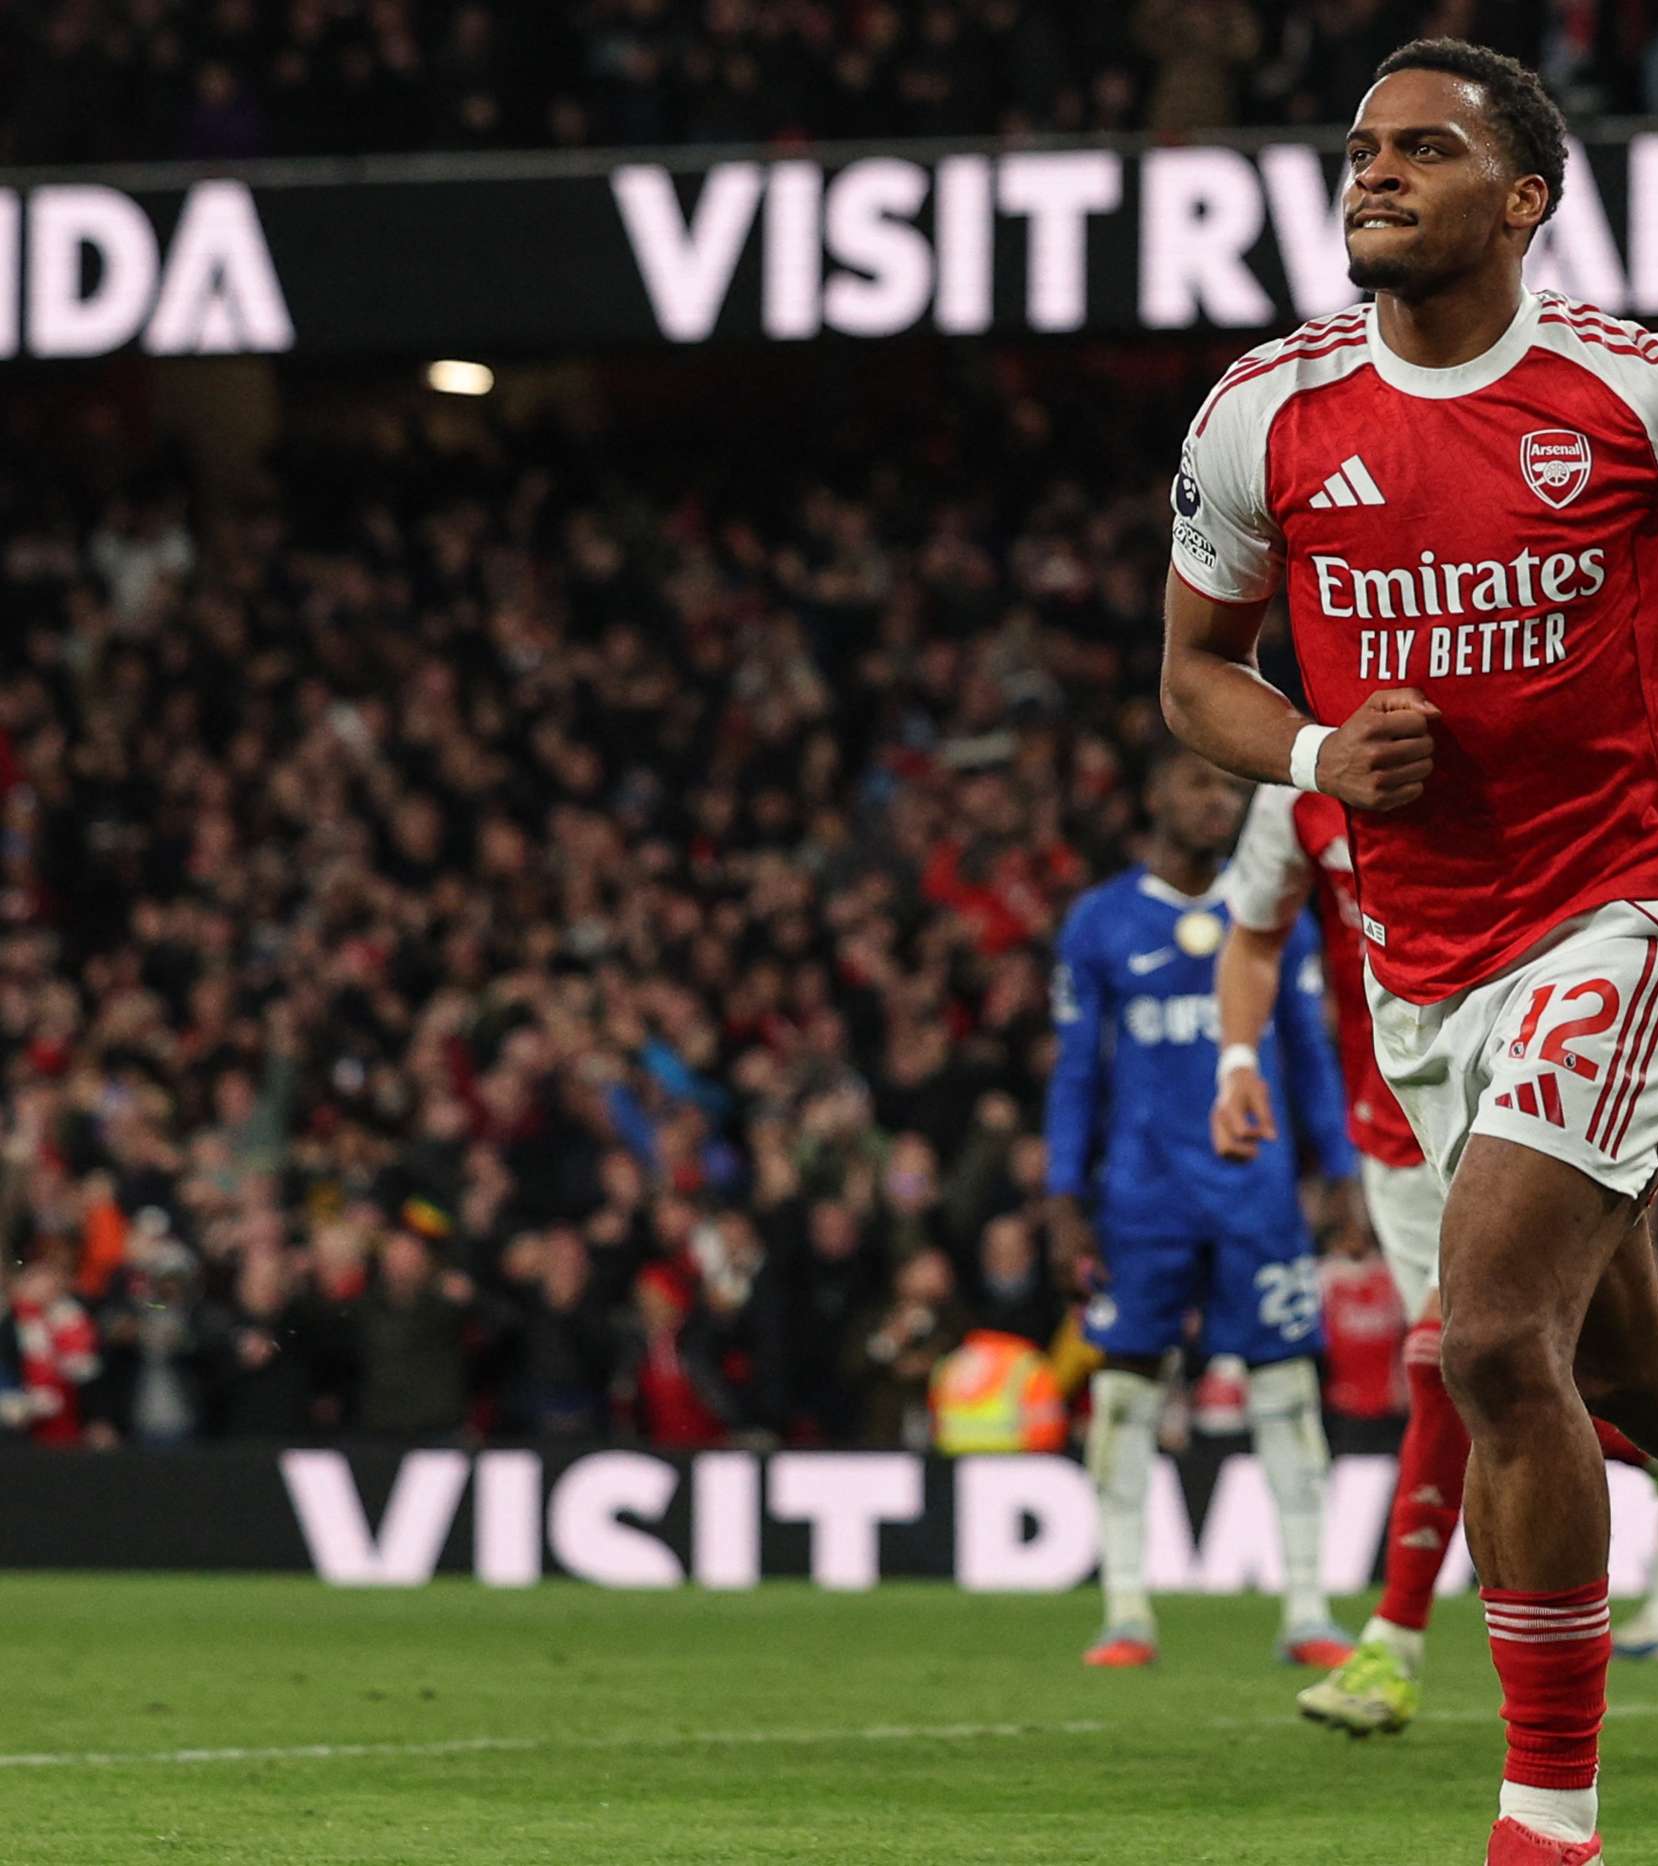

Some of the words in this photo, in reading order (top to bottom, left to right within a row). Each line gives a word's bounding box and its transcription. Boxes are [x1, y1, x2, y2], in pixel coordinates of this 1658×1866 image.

[0, 177, 297, 361] DA
[608, 150, 1122, 343] VISIT
[1531, 443, 1580, 456] Arsenal
[1311, 547, 1605, 618] Emirates
[1360, 629, 1415, 681] FLY
[1429, 612, 1567, 678] BETTER
[1508, 977, 1620, 1082] 12
[279, 1449, 924, 1588] VISIT
